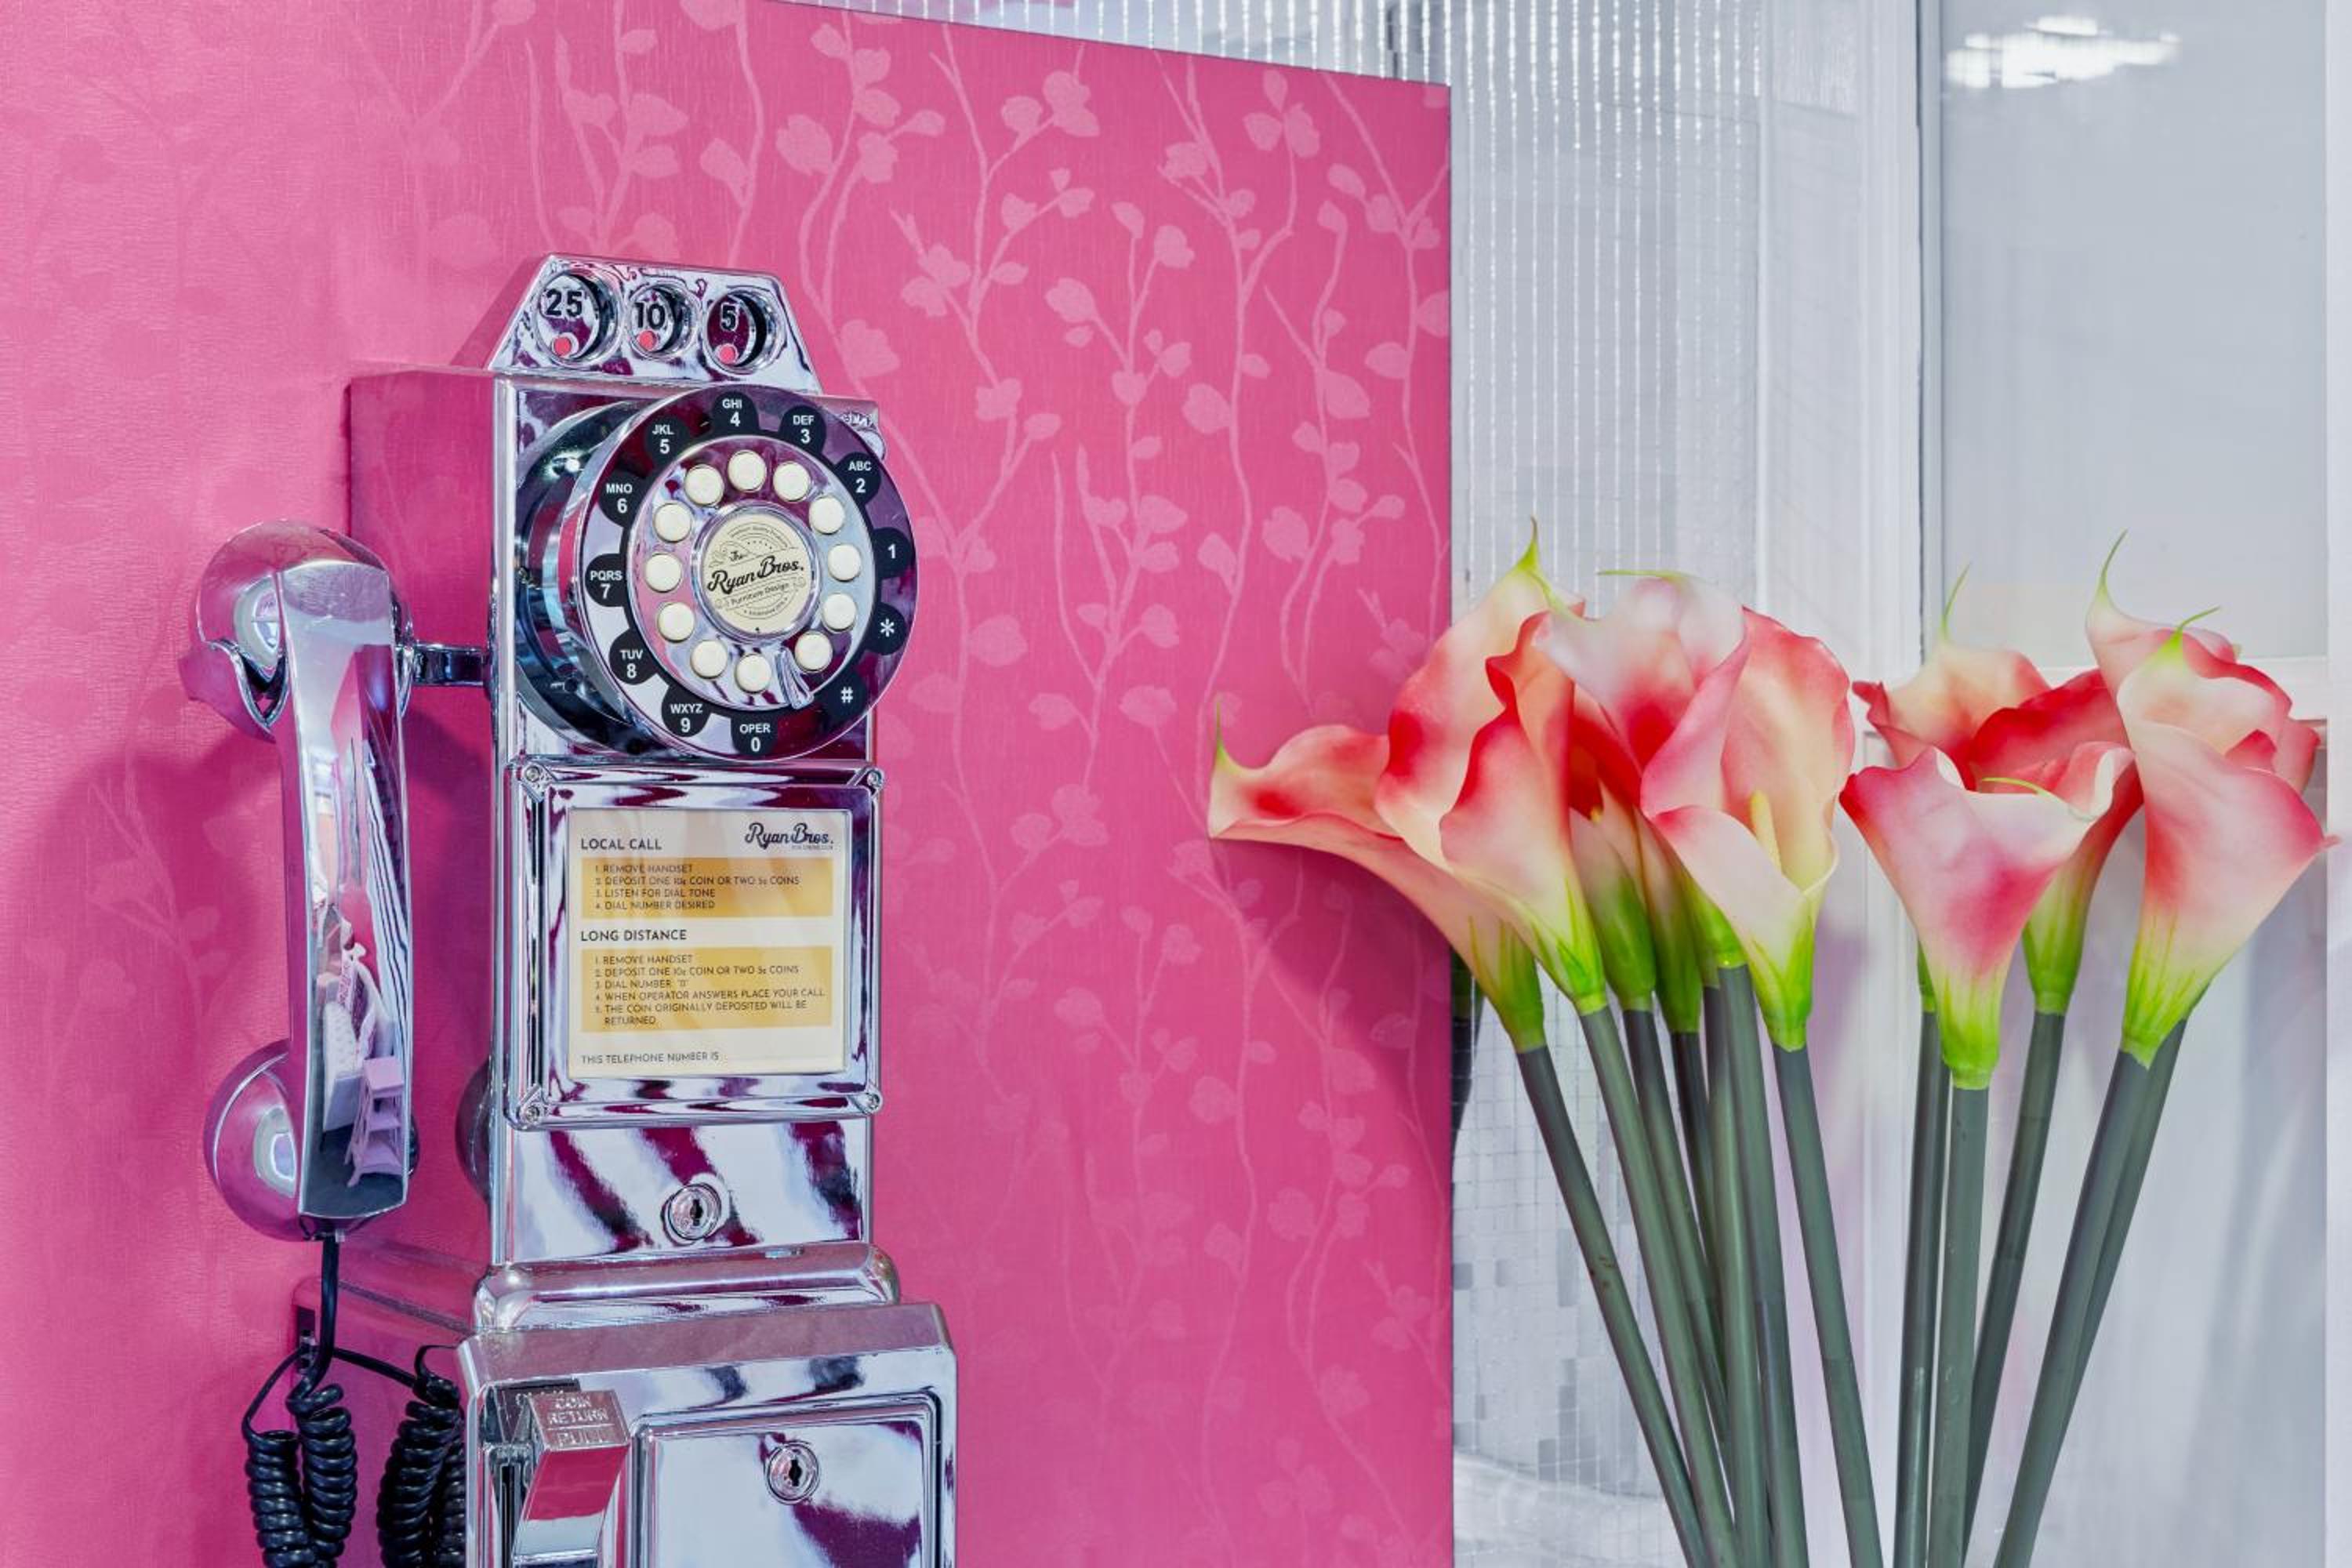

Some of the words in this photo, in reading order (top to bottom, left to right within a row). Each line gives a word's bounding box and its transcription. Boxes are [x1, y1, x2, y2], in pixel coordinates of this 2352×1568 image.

[546, 288, 583, 317] 25
[633, 302, 666, 330] 10
[720, 304, 737, 330] 5
[721, 398, 742, 409] GHI
[729, 412, 741, 426] 4
[793, 415, 815, 425] DEF
[652, 424, 674, 435] JKL
[800, 429, 810, 444] 3
[659, 439, 670, 454] 5
[848, 460, 871, 471] ABC
[606, 483, 633, 494] MNO
[855, 477, 866, 493] 2
[617, 499, 627, 514] 6
[887, 544, 896, 558] 1
[590, 570, 622, 581] PQRS
[707, 570, 754, 594] Ryan
[757, 555, 804, 579] Bros.
[601, 583, 611, 598] 7
[620, 649, 643, 660] TUV
[626, 662, 637, 678] 8
[670, 703, 702, 714] WXYZ
[681, 718, 691, 733] 9
[739, 724, 771, 734] OPER
[750, 737, 760, 753] 0
[744, 822, 789, 850] Ryan
[791, 822, 834, 844] Bros.
[581, 838, 625, 850] LOCAL
[630, 838, 662, 850] CALL
[603, 865, 645, 873] REMOVE
[648, 864, 693, 873] HANDSET
[604, 876, 647, 885] DEPOSIT
[649, 876, 670, 885] ONE
[689, 876, 714, 885] COIN
[717, 876, 731, 885] OR
[734, 876, 754, 885] TWO
[769, 876, 800, 885] COINS
[604, 888, 638, 897] LISTEN
[641, 888, 661, 897] FOR
[664, 888, 687, 897] DIAL
[690, 888, 716, 897] TONE
[604, 901, 627, 909] DIAL
[630, 901, 672, 909] NUMBER
[674, 900, 716, 909] DESIRED
[581, 930, 619, 942] LONG
[624, 929, 687, 941] DISTANCE
[603, 956, 645, 964] REMOVE
[648, 955, 693, 964] HANDSET
[604, 967, 646, 977] DEPOSIT
[648, 967, 670, 976] ONE
[689, 966, 714, 975] COIN
[716, 966, 730, 975] OR
[733, 965, 755, 975] TWO
[769, 965, 800, 975] COINS
[604, 980, 627, 989] DIAL
[630, 980, 672, 989] NUMBER
[604, 993, 637, 1001] WHEN
[639, 991, 689, 1000] OPERATOR
[692, 990, 739, 1000] ANSWERS
[741, 989, 770, 998] PLACE
[772, 989, 797, 997] YOUR
[604, 1004, 623, 1013] THE
[626, 1004, 652, 1014] COIN
[655, 1003, 713, 1012] ORIGINALLY
[716, 1001, 768, 1011] DEPOSITED
[770, 1000, 793, 1009] WILL
[796, 1000, 808, 1009] BE
[604, 1015, 656, 1025] RETURNED
[582, 1055, 603, 1064] THIS
[606, 1053, 664, 1064] TELEPHONE
[667, 1051, 708, 1062] NUMBER
[710, 1051, 719, 1060] IS
[555, 1395, 592, 1408] COIN
[548, 1408, 608, 1424] RETURN
